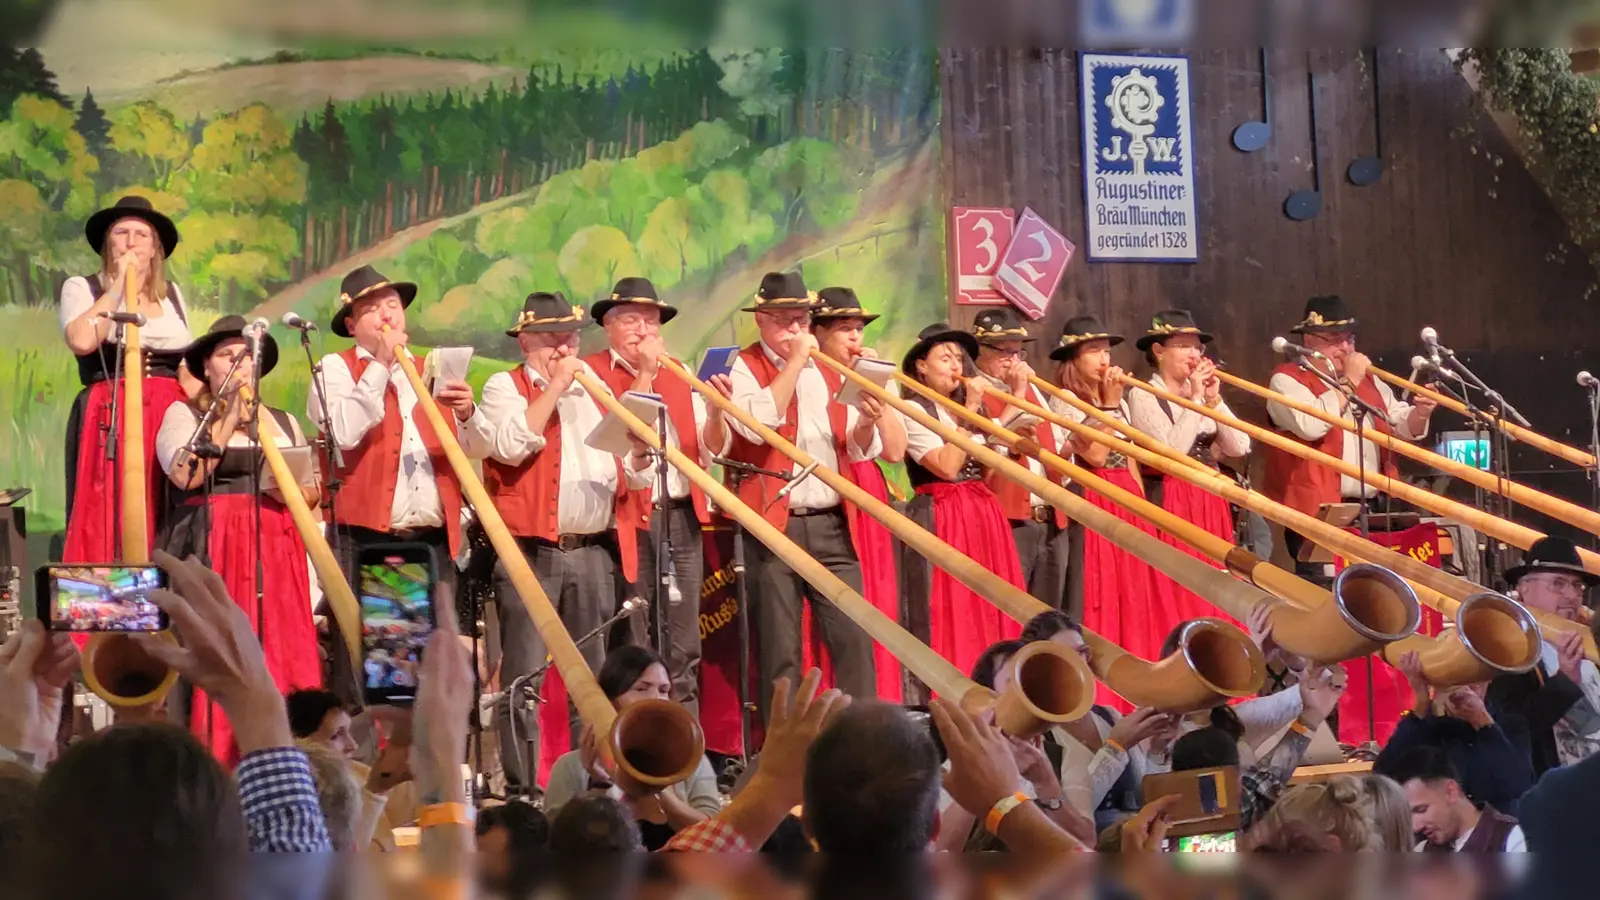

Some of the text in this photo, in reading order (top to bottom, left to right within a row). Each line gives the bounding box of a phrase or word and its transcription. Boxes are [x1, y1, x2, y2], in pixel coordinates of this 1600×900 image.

[1102, 136, 1178, 162] J. W.
[972, 217, 998, 273] 3
[1014, 230, 1052, 282] 2
[1097, 231, 1188, 250] gegründet 1328
